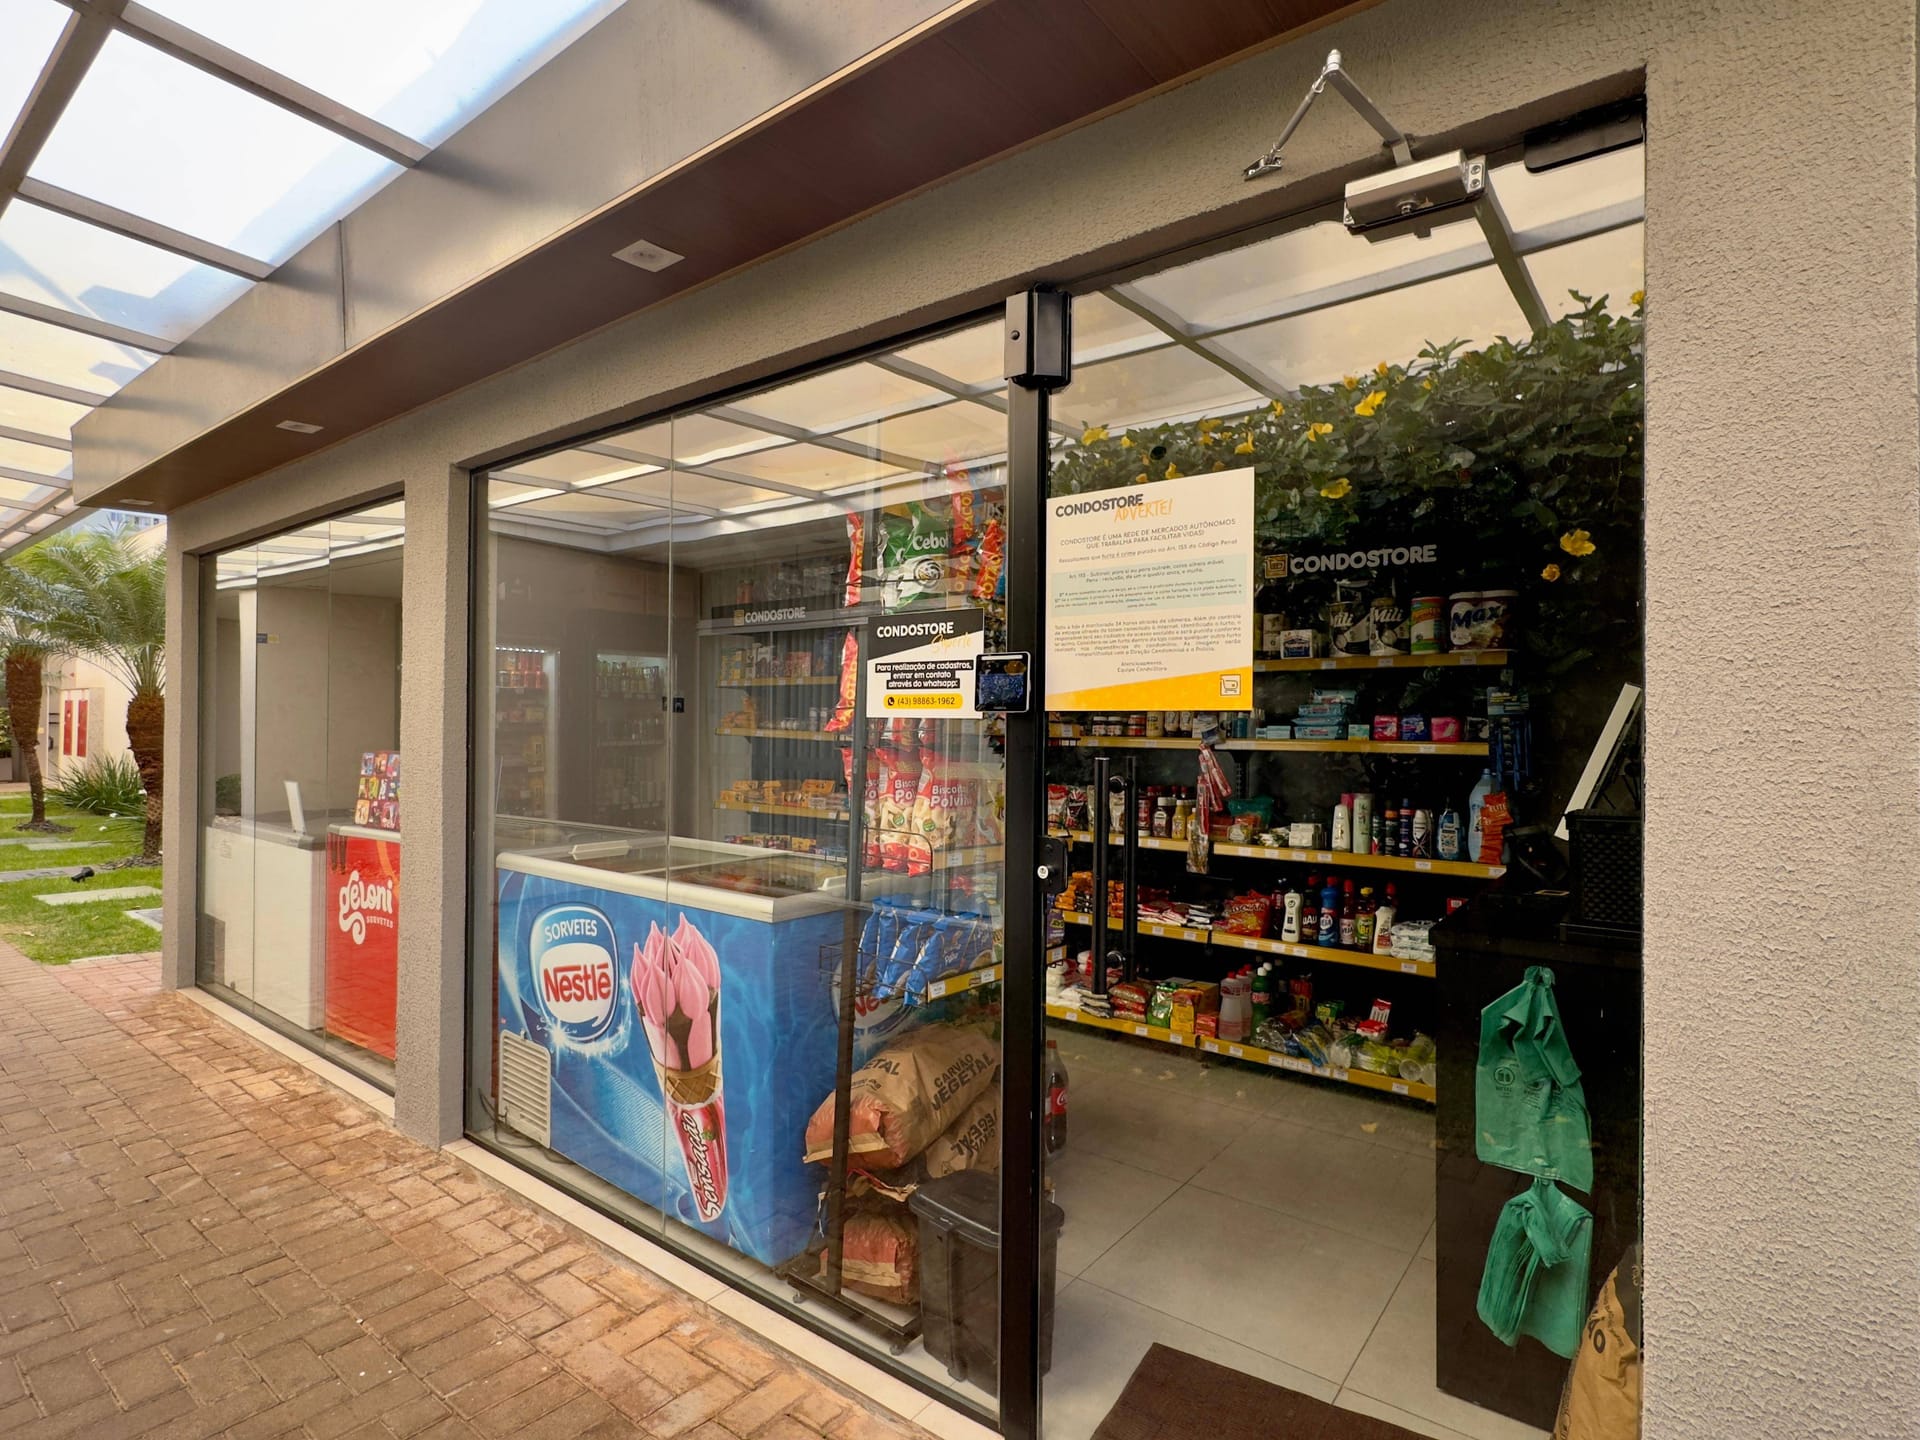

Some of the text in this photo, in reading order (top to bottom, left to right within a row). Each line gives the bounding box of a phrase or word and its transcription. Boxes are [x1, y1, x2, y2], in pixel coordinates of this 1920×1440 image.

[1055, 494, 1143, 518] CONDOSTORE
[1114, 498, 1173, 523] ADVERTE!
[1060, 535, 1101, 546] CONDOSTORE
[1107, 532, 1122, 540] UMA
[1124, 530, 1139, 538] REDE
[1151, 524, 1188, 534] MERCADOS
[1189, 518, 1236, 530] AUTÔNOMOS
[1086, 541, 1098, 549] QUE
[1101, 538, 1132, 547] TRABALHA
[1289, 544, 1437, 574] CONDOSTORE
[744, 606, 806, 623] CONDOSTORE
[1373, 605, 1404, 623] Mili
[876, 622, 954, 638] CONDOSTORE
[892, 662, 926, 671] realização
[927, 662, 935, 670] de
[936, 661, 972, 670] cadastros,
[893, 671, 913, 679] entrar
[925, 671, 951, 679] contato
[888, 679, 912, 688] através
[912, 679, 922, 688] do
[897, 696, 955, 706] (43) 98863-1962
[339, 870, 393, 945] geloni
[544, 918, 598, 943] SORVETES
[543, 961, 612, 1003] Nestlé
[931, 1052, 994, 1111] VEGETAL
[934, 1053, 974, 1088] CARVÃO
[679, 1110, 722, 1219] Sensação
